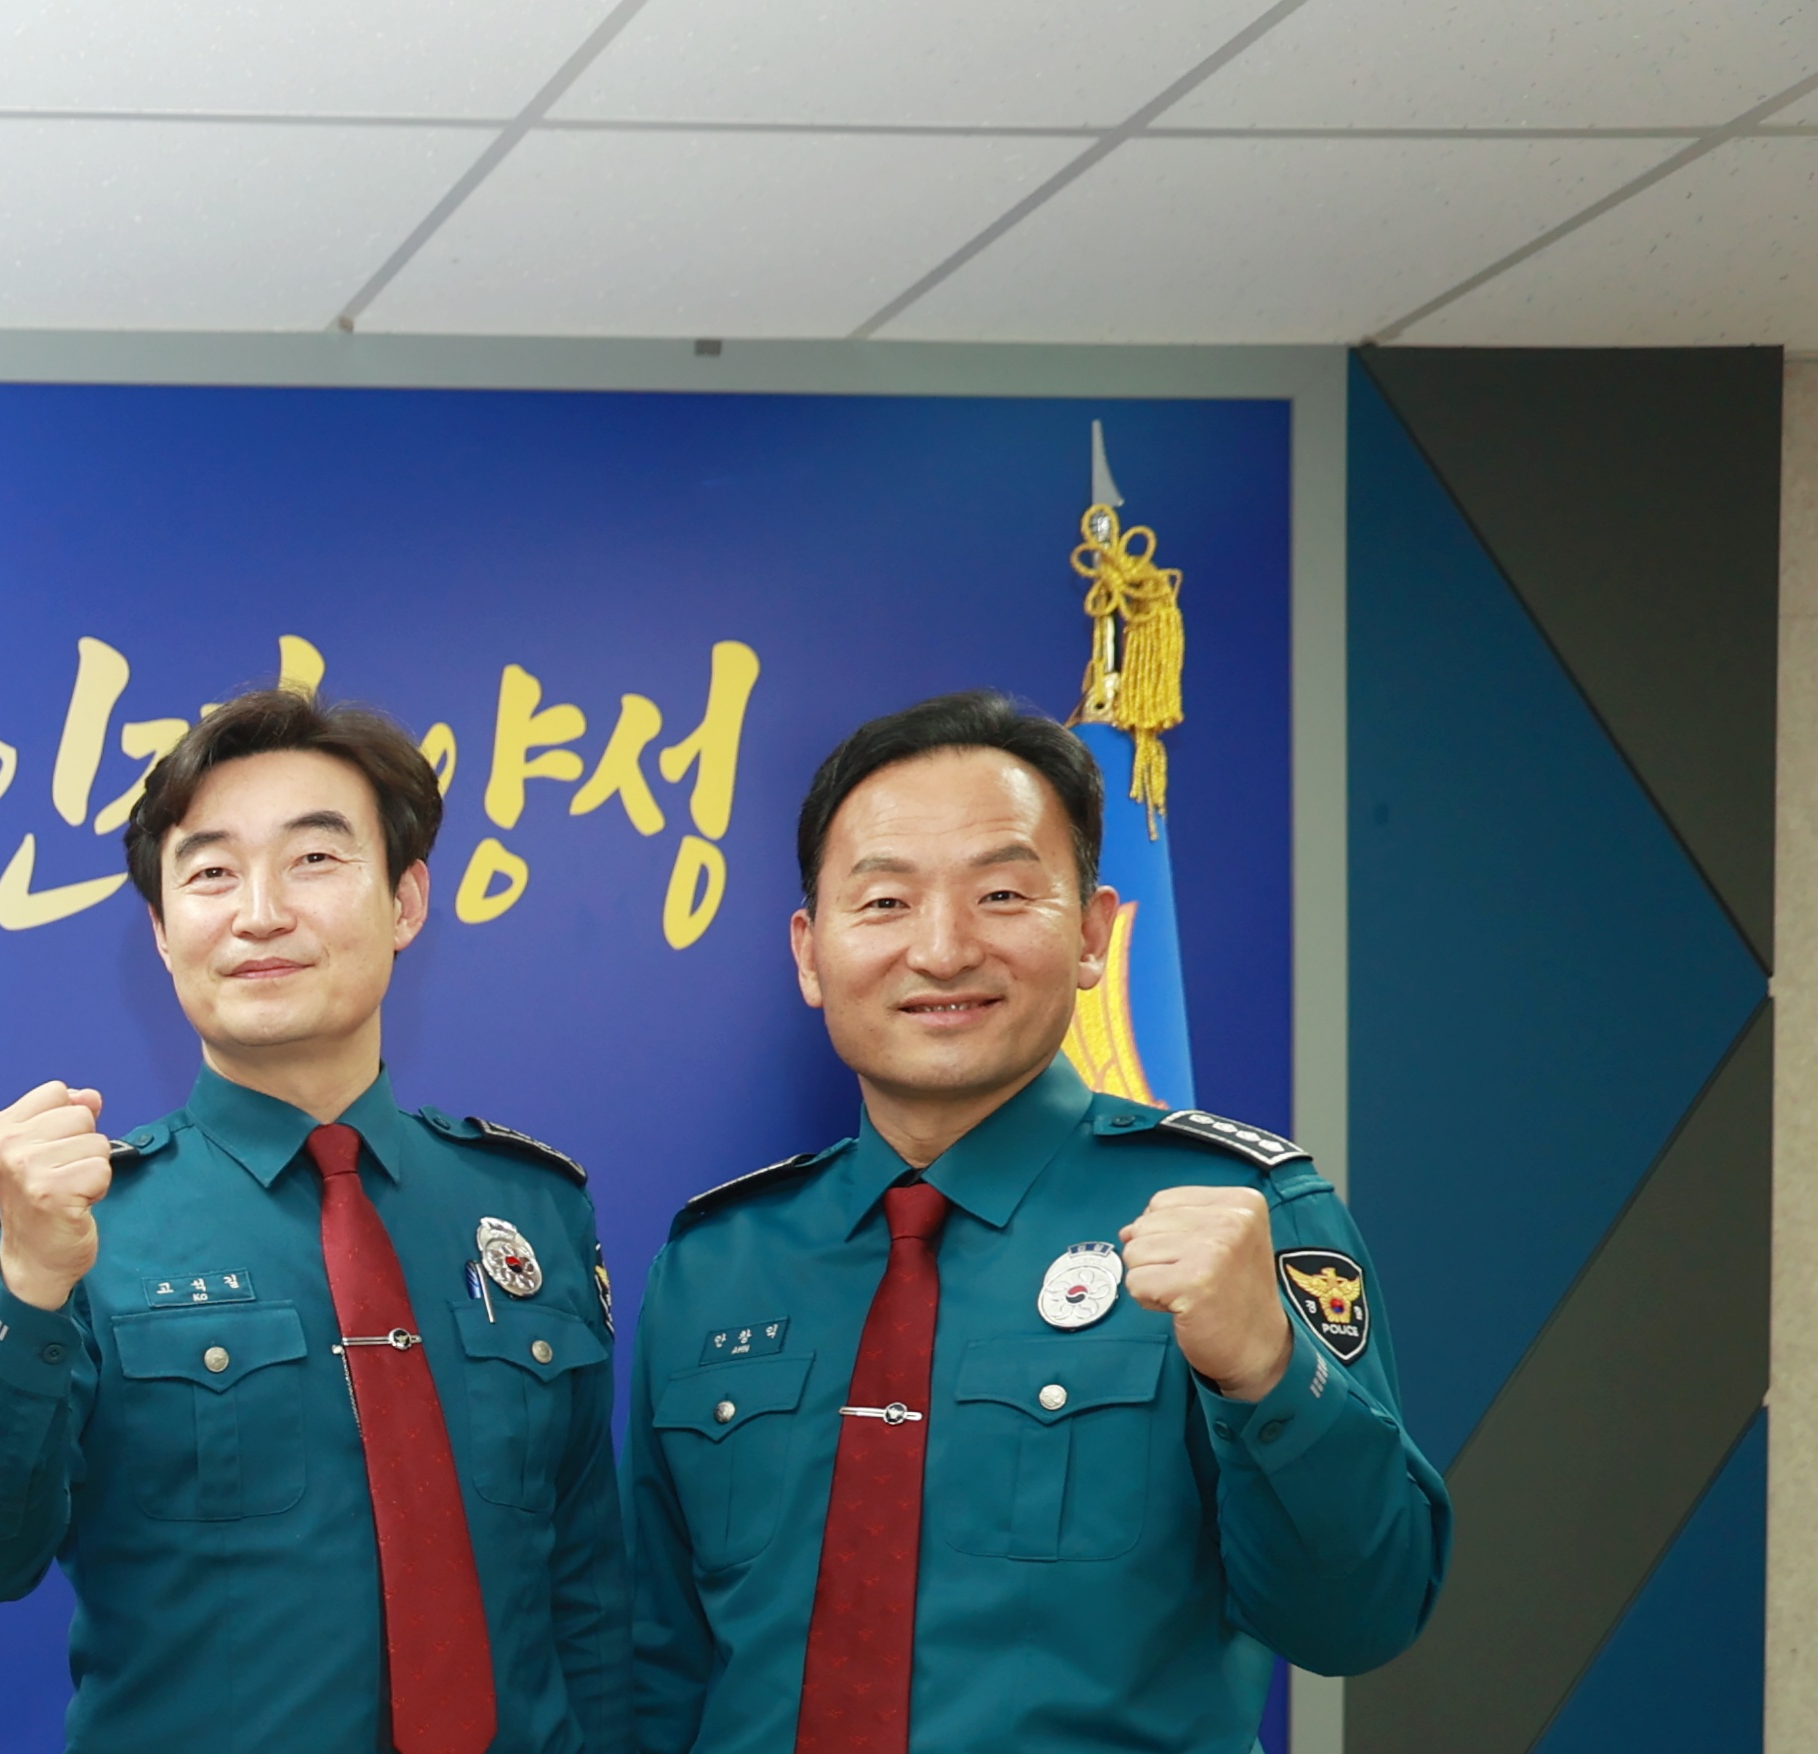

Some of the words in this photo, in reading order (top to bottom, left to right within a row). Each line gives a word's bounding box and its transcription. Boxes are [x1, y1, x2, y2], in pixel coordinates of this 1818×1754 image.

[422, 640, 761, 951] 양성
[192, 1293, 208, 1302] KO
[1321, 1323, 1359, 1337] POLICE
